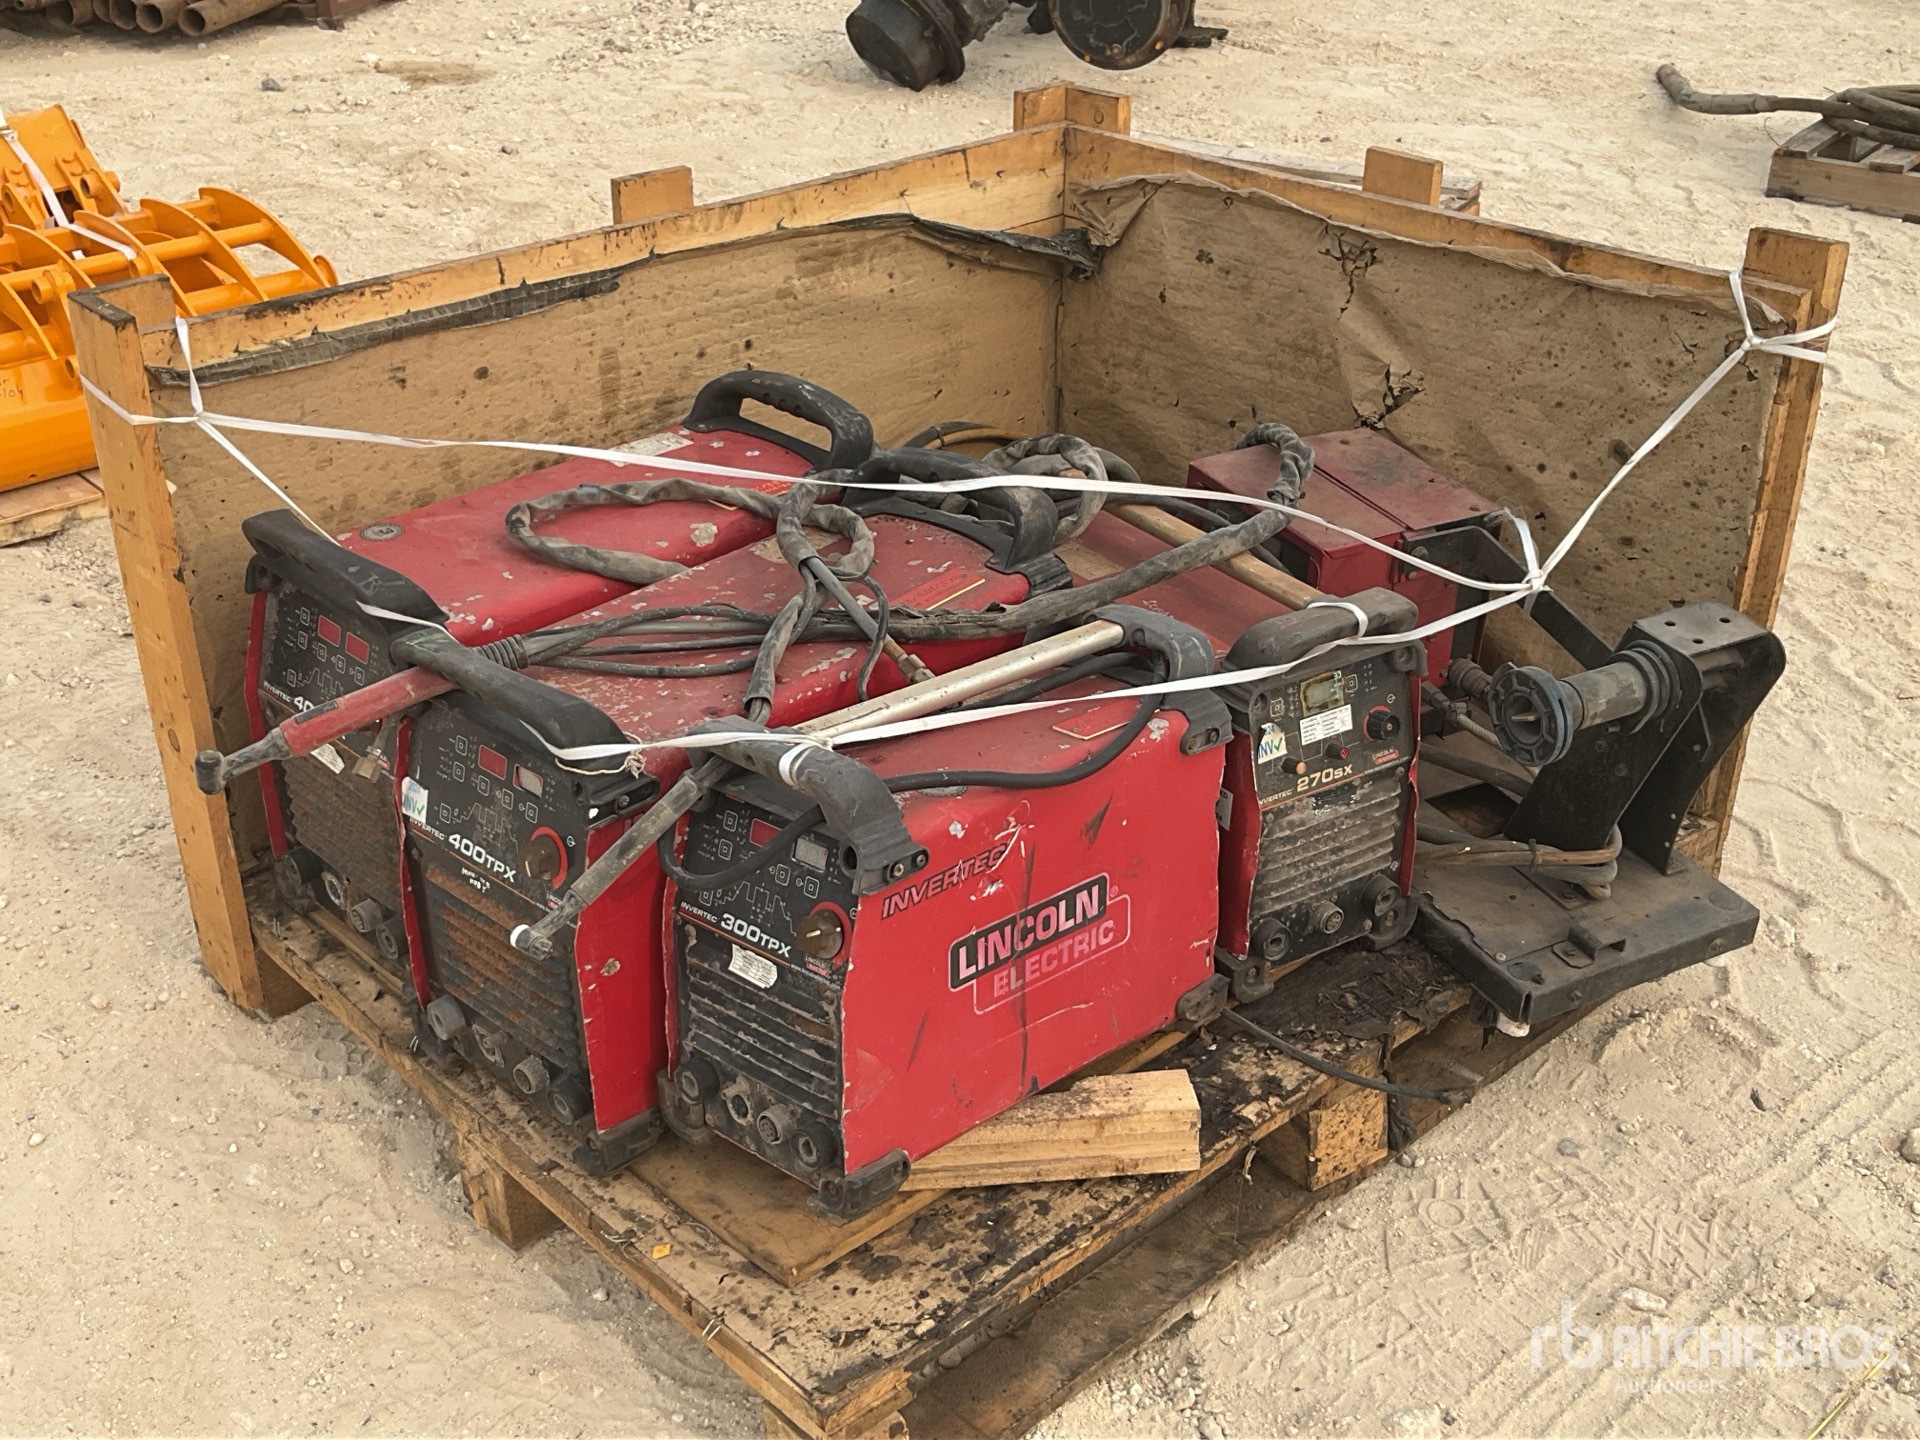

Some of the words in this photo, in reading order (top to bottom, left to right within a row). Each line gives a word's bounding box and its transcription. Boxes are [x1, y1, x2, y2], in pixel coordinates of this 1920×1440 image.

[1259, 788, 1293, 806] NVERTEC
[448, 833, 517, 884] 400TPX
[881, 844, 1009, 920] INVERTEC
[680, 901, 718, 923] INVERTEC
[720, 913, 792, 959] 300TPX
[958, 884, 1100, 980] LINCOLN
[993, 919, 1115, 998] ELECTRIC
